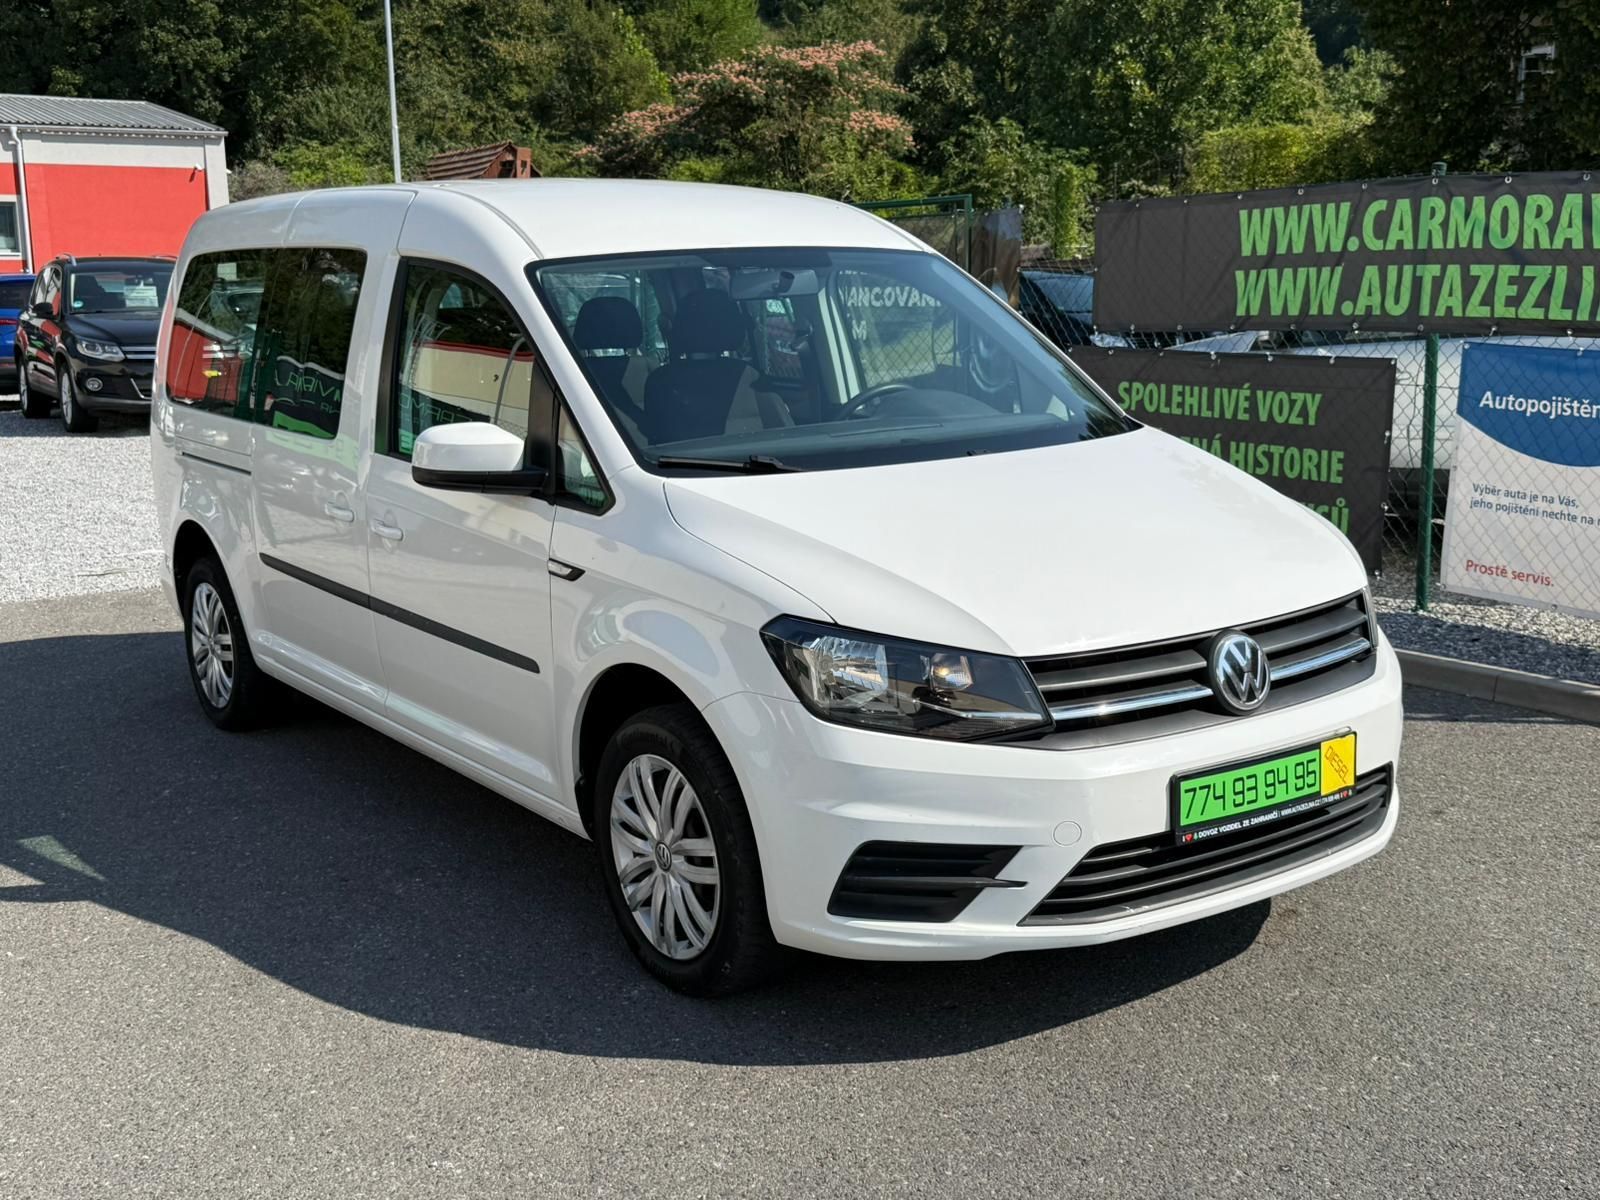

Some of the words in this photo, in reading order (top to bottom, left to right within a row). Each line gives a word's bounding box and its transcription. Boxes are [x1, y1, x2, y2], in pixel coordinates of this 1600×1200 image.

[1239, 193, 1600, 256] WWW.CARMORA
[1235, 264, 1600, 321] WWW.AUTAZEZLI
[1118, 381, 1251, 421] SPOLEHLIVÉ
[1256, 390, 1322, 425] VOZY
[1230, 440, 1344, 484] HISTORIE
[1469, 496, 1493, 510] jeho
[1495, 501, 1539, 516] pojištění
[1541, 507, 1578, 522] nechte
[1580, 516, 1594, 525] na
[1472, 483, 1502, 497] Výběr
[1504, 488, 1527, 500] auta
[1529, 489, 1539, 503] je
[1541, 494, 1555, 505] na
[1558, 494, 1580, 508] Vás,
[1465, 559, 1508, 578] Prostě
[1511, 569, 1554, 587] servis.
[1324, 746, 1349, 785] DIESEL
[1184, 782, 1226, 819] 774
[1233, 775, 1258, 808] 93
[1265, 766, 1288, 800] 94
[1294, 758, 1318, 792] 95
[1198, 828, 1218, 838] DOVOZ
